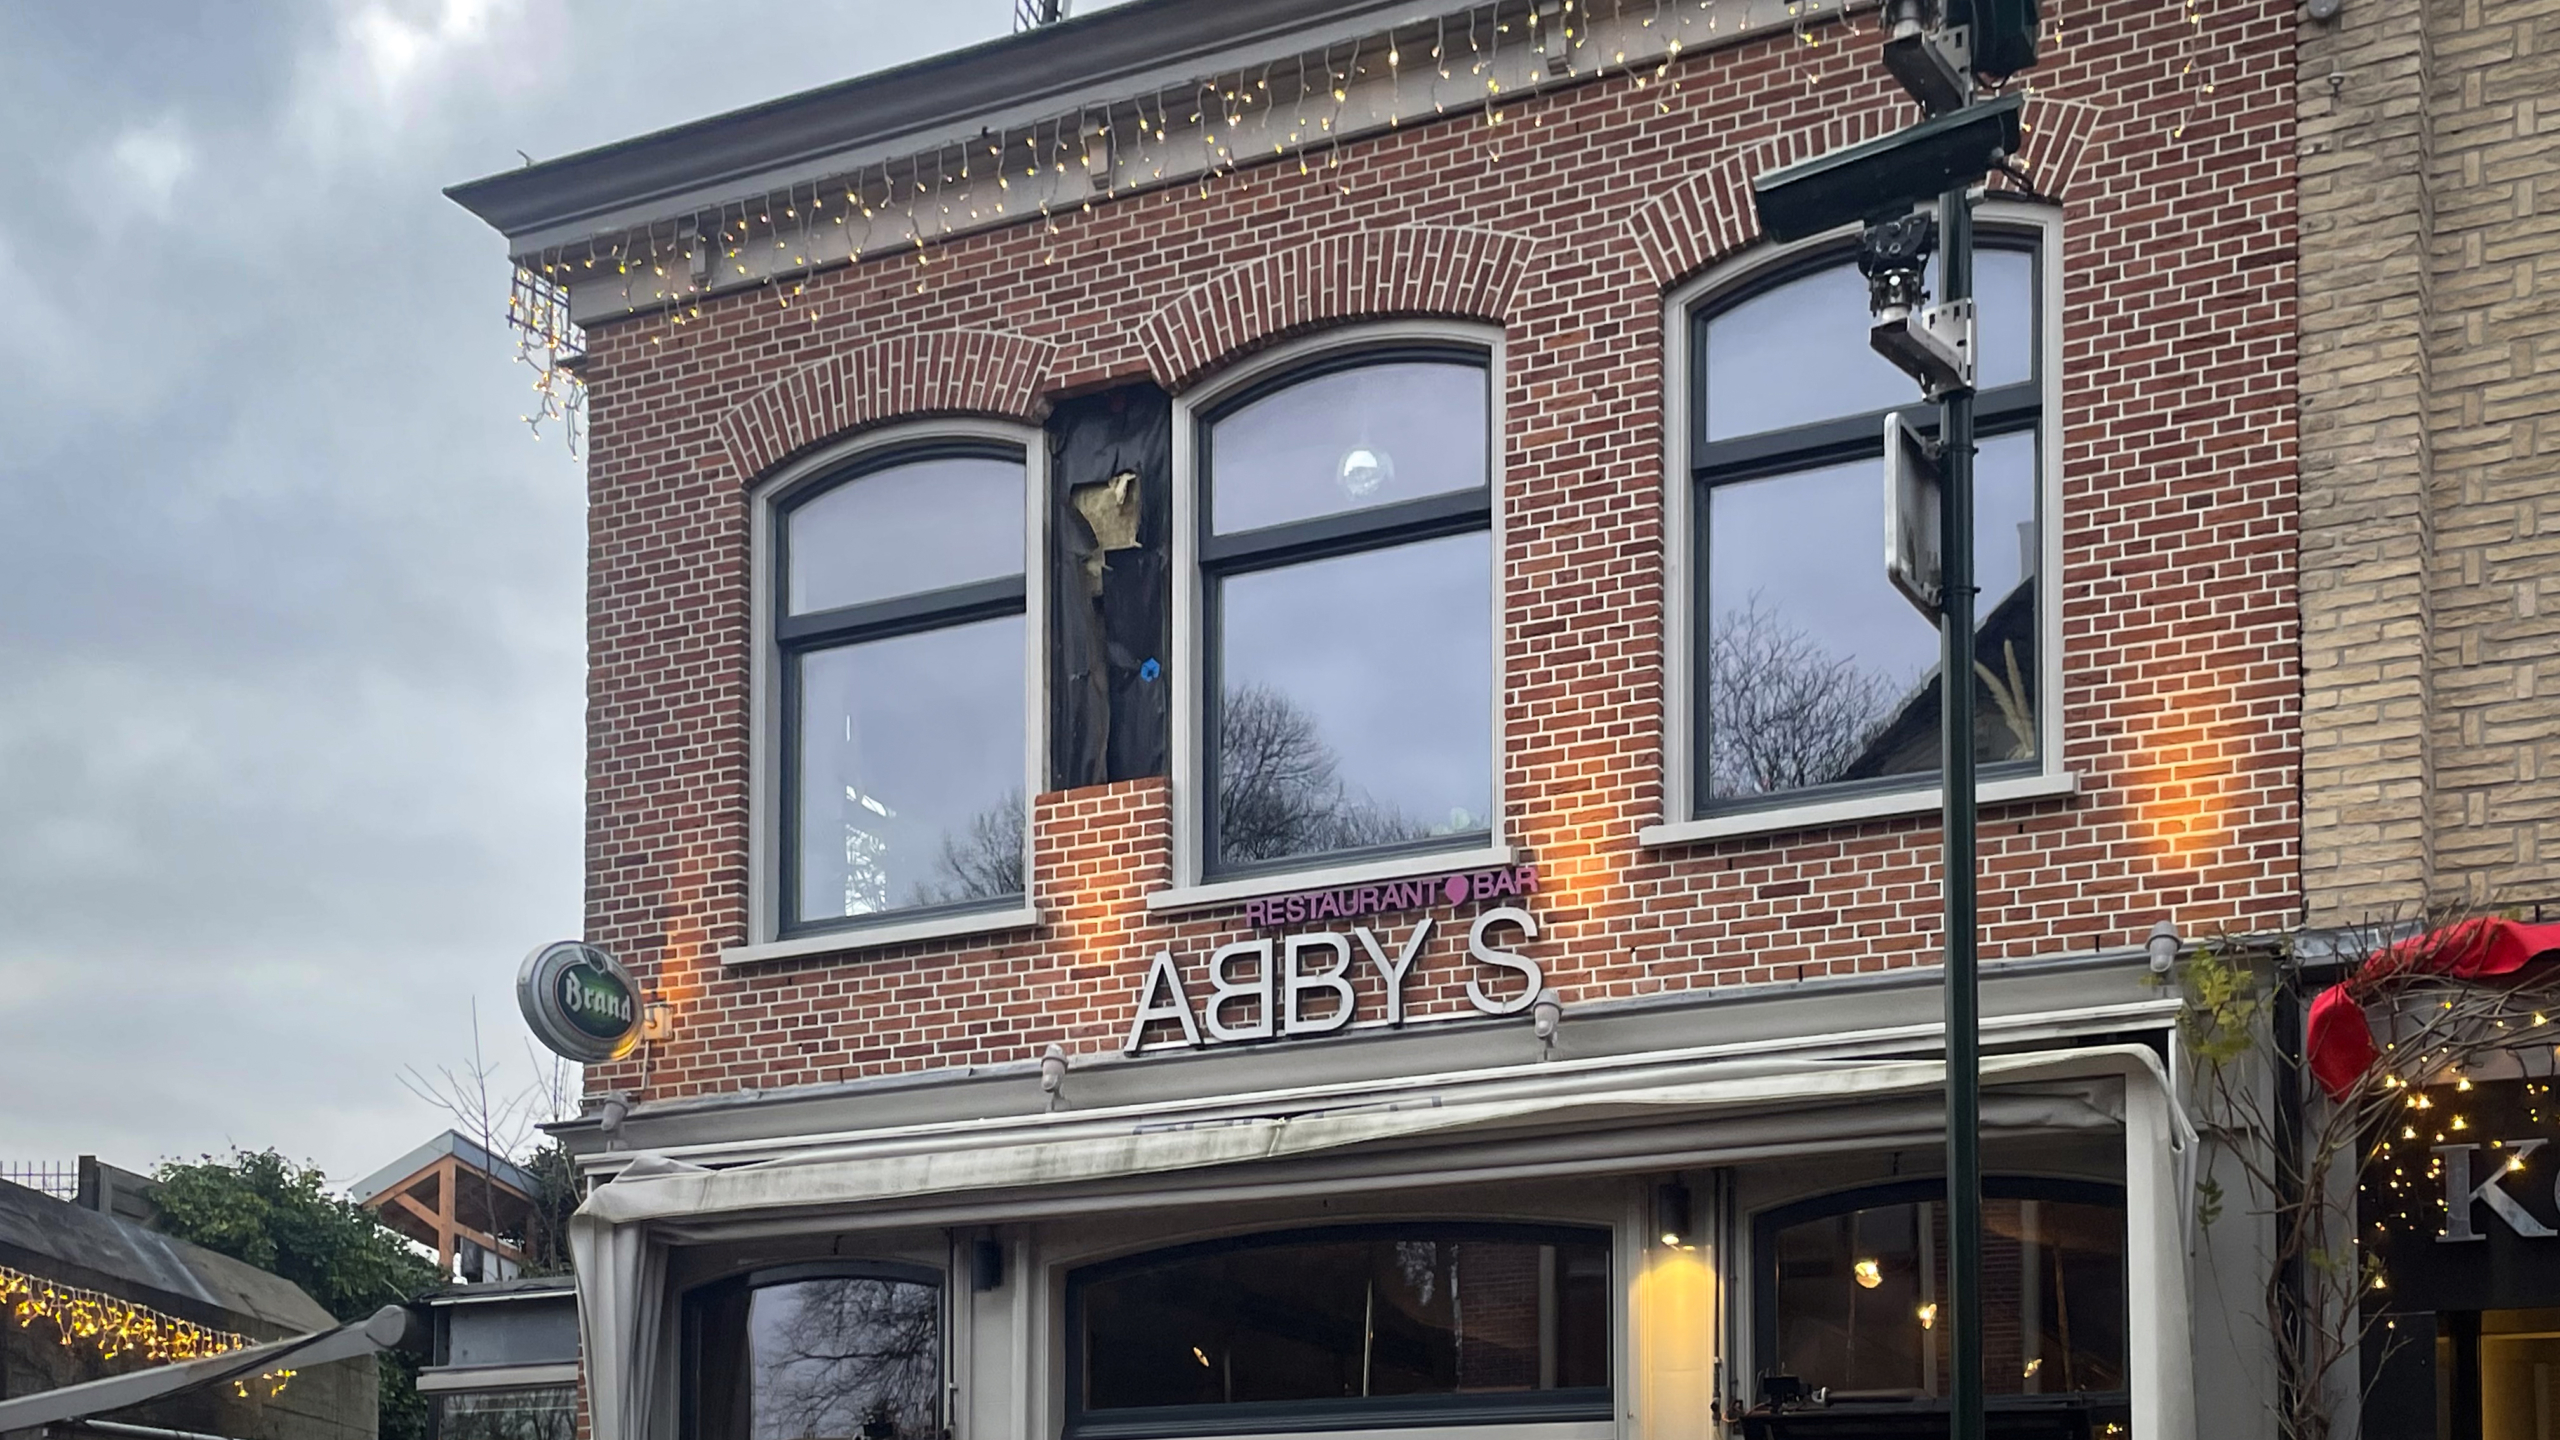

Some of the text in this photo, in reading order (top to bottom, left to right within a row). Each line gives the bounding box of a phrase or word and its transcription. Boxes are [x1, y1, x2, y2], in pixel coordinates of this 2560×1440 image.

[1246, 866, 1538, 927] RESTAURANT BAR
[565, 970, 631, 1023] Brand
[2430, 1138, 2560, 1242] K
